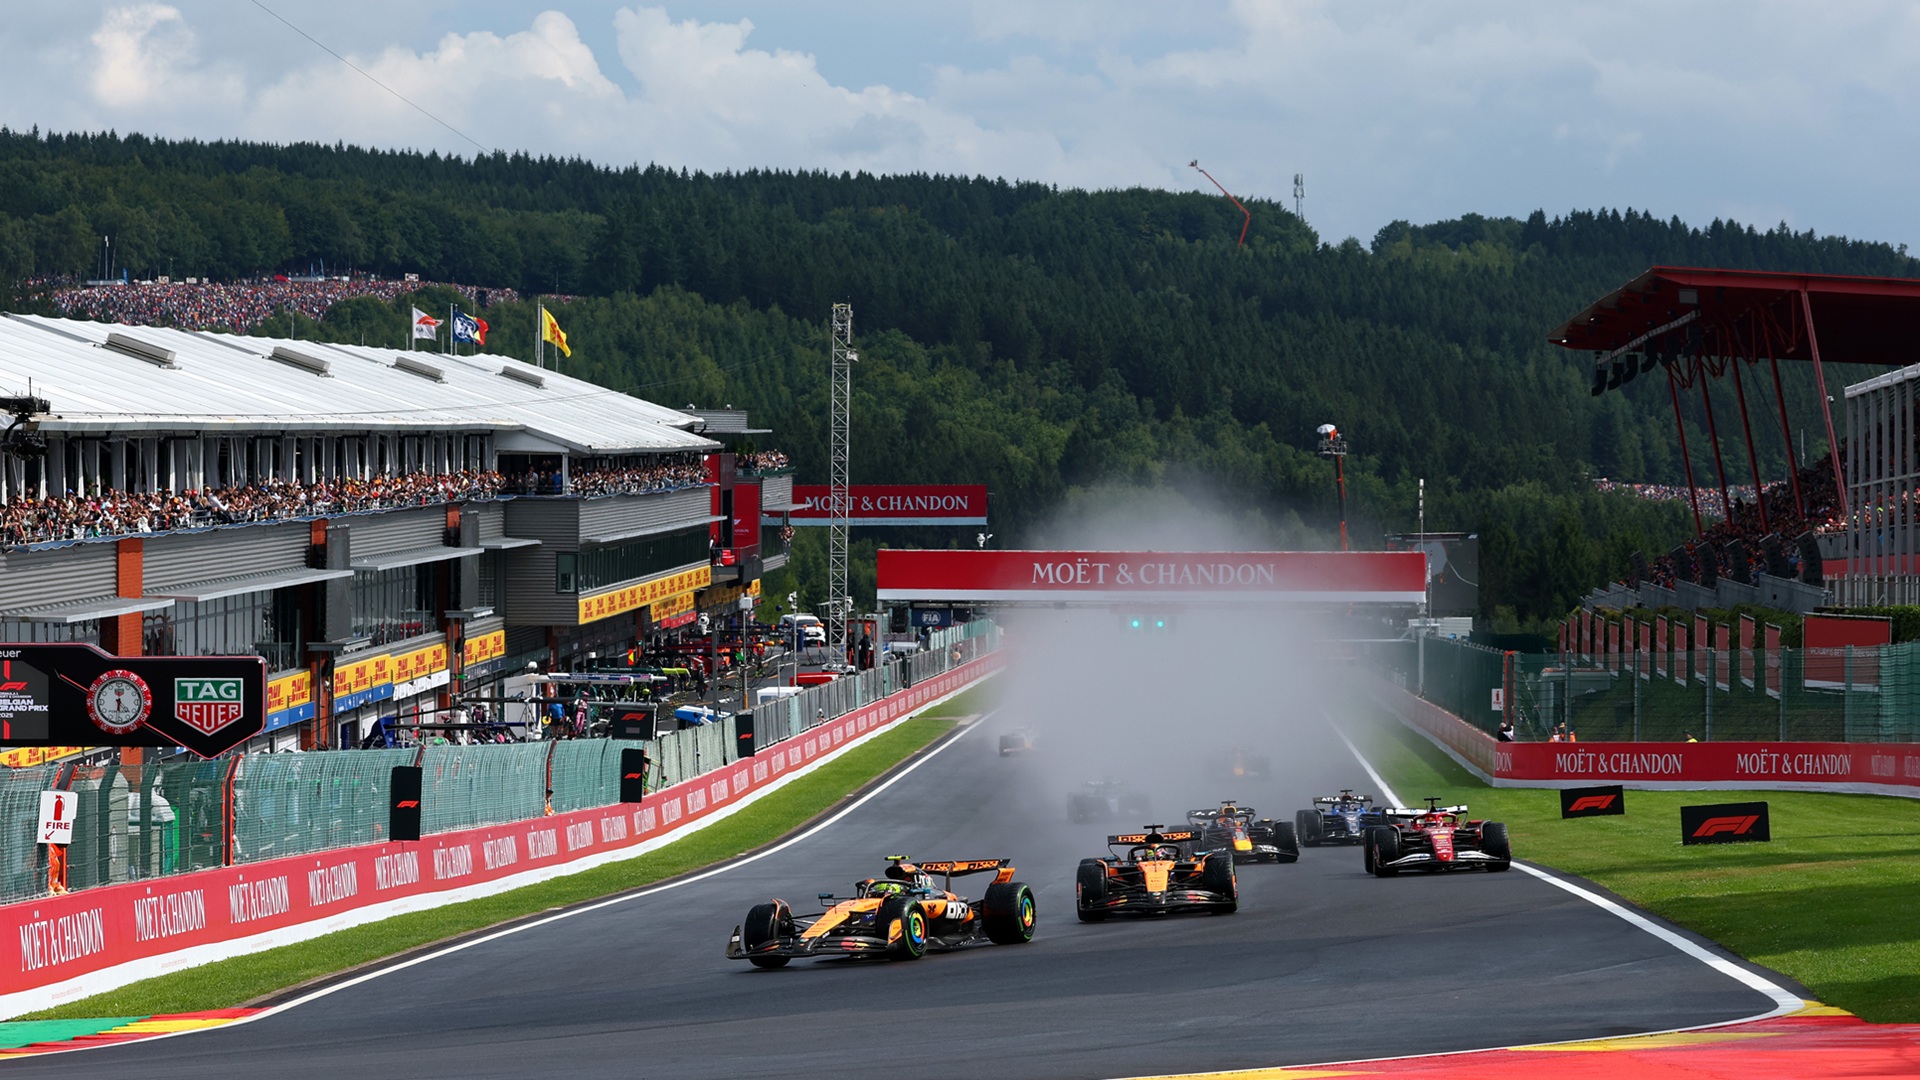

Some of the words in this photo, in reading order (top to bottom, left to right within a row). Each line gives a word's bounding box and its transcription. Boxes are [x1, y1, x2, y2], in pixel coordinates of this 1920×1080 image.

[861, 495, 874, 511] &
[876, 495, 969, 511] CHANDON
[1032, 558, 1111, 584] MOËT
[1115, 563, 1135, 585] &
[1139, 563, 1275, 585] CHANDON
[923, 613, 939, 622] FIA
[181, 682, 237, 699] TAG
[179, 704, 239, 731] HEUER
[1555, 748, 1596, 773] MOËT
[1598, 753, 1608, 773] &
[1610, 753, 1683, 774] CHANDON
[1736, 749, 1779, 774] MOËT
[1781, 753, 1792, 774] &
[1794, 754, 1851, 775] CHANDON
[45, 821, 71, 830] FIRE
[307, 860, 327, 907] MOËT
[228, 874, 250, 924] MOËT
[250, 881, 257, 921] &
[255, 876, 290, 918] CHANDON
[134, 886, 159, 942] MOËT
[160, 895, 168, 937] &
[166, 889, 206, 936] CHANDON
[19, 909, 49, 972] MOËT
[50, 918, 59, 966] &
[57, 907, 105, 963] CHANDON
